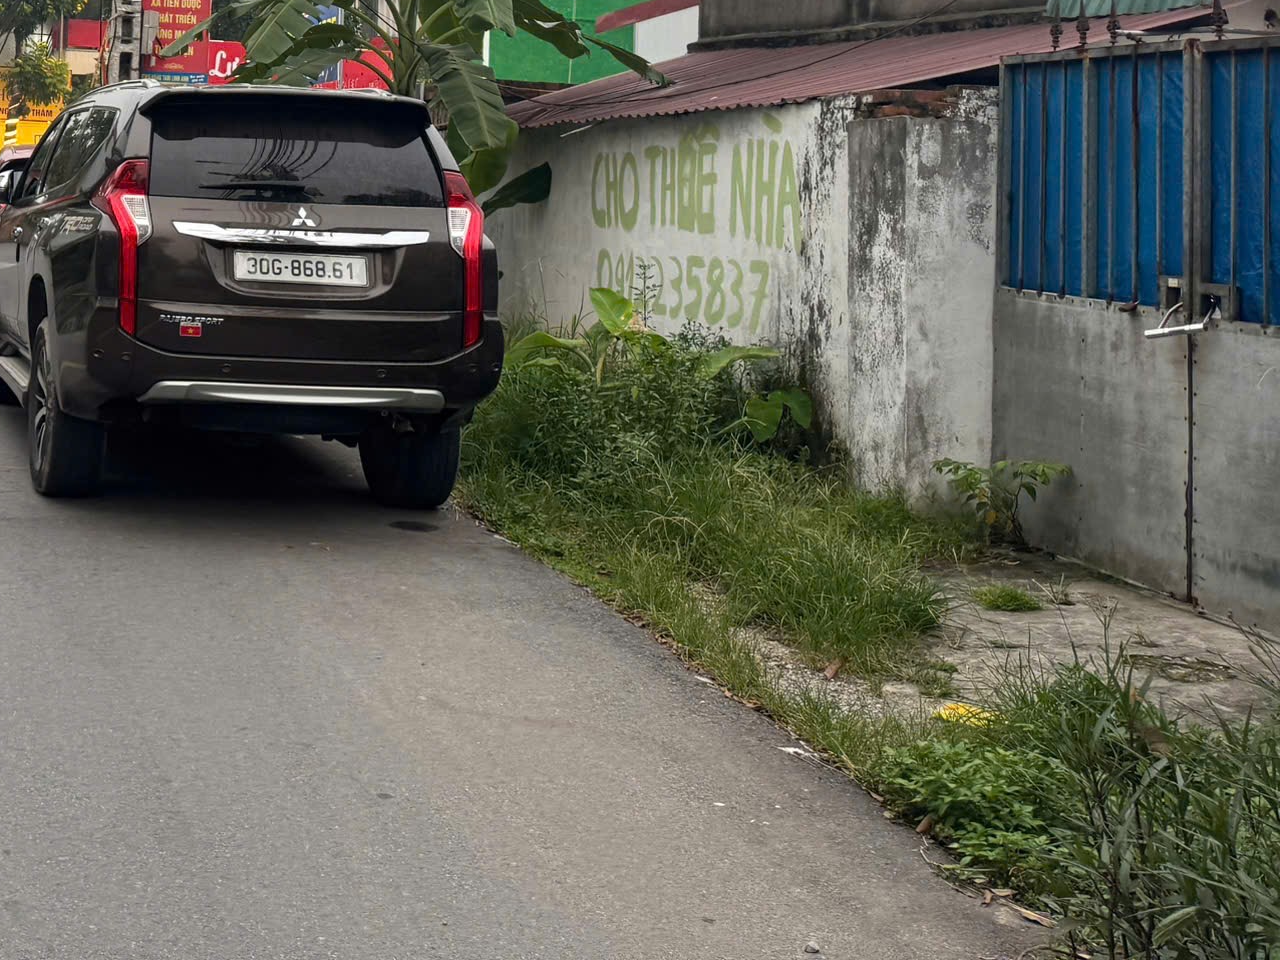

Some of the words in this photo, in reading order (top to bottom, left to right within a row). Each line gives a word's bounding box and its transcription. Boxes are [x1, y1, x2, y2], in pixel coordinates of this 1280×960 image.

[159, 12, 174, 24] HÁT
[591, 151, 640, 232] CHO
[729, 112, 803, 256] NHÀ
[246, 256, 354, 281] 30G-868.61
